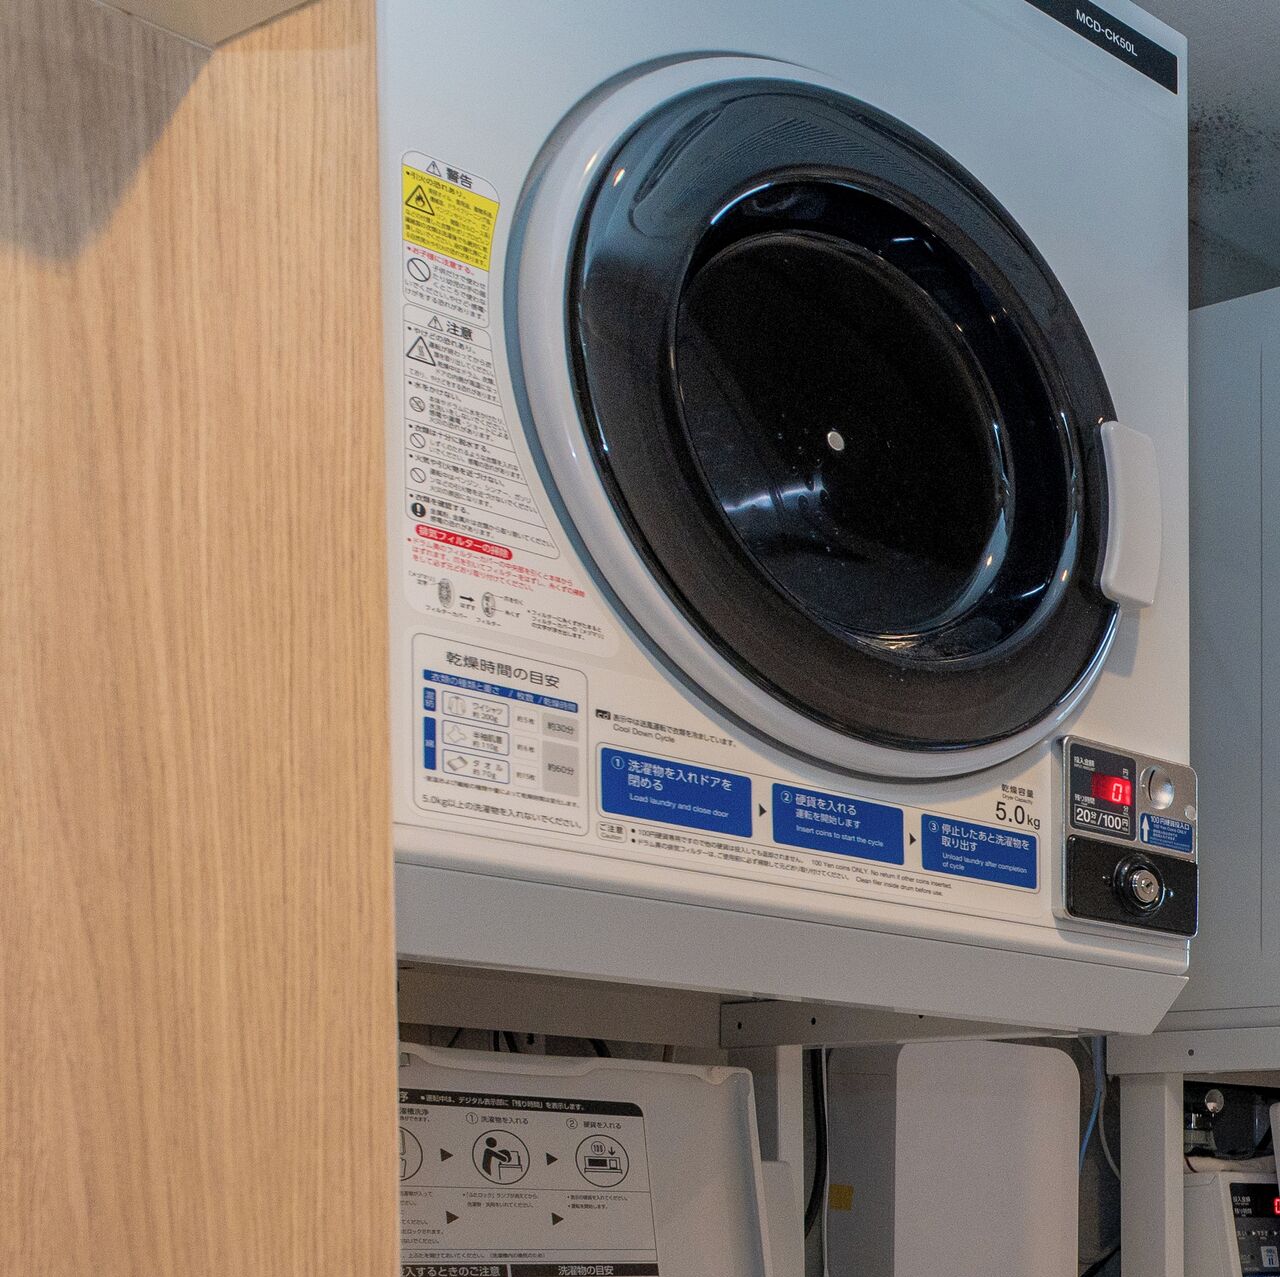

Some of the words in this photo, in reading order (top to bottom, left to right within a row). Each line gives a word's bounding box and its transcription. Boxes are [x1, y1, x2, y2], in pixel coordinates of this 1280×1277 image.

[1076, 8, 1138, 57] MCD-CK50L
[446, 167, 473, 189] 警告
[446, 320, 473, 341] 注意
[446, 651, 560, 689] 乾燥時間の目安
[613, 724, 630, 734] Cool
[632, 727, 653, 739] Down
[654, 733, 675, 744] Cycle
[628, 760, 733, 791] 洗濯物を入れドアを
[628, 773, 663, 791] 閉める
[1002, 783, 1033, 800] 乾燥容量
[678, 800, 692, 810] and
[795, 794, 857, 816] 硬貨を入れる
[600, 822, 623, 836] ご注意
[795, 809, 861, 829] 運転を開始します
[795, 824, 813, 835] Insert
[814, 829, 832, 838] coins
[841, 834, 854, 842] start
[856, 835, 866, 843] the
[942, 824, 1030, 850] 停止したあと洗濯物を
[942, 836, 977, 852] 取り出す
[942, 852, 962, 862] Unload
[998, 862, 1028, 873] completion
[558, 1265, 615, 1276] 洗濯物の目安
